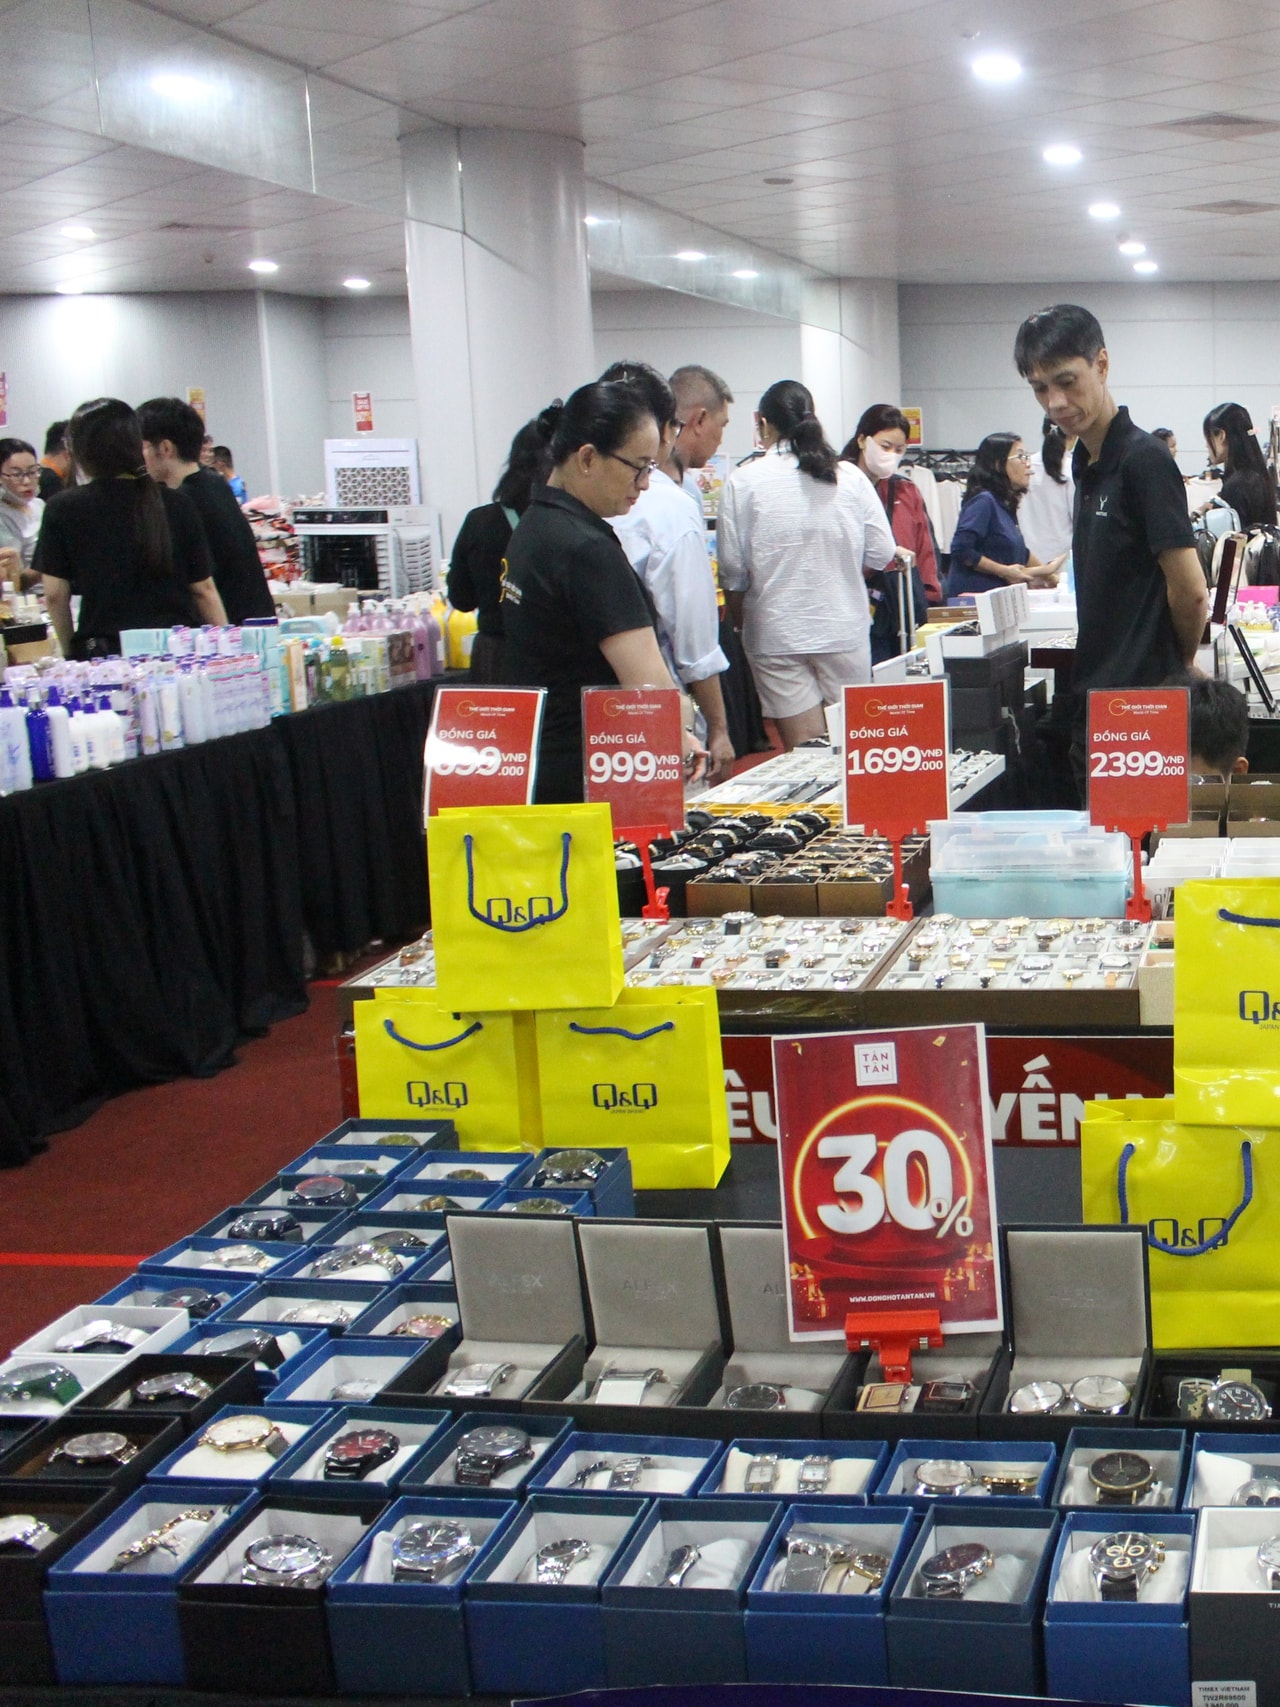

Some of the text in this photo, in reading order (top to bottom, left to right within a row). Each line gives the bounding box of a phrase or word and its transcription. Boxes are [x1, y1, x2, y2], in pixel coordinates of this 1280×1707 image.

[476, 728, 497, 740] GIÁ
[887, 724, 909, 737] GIÁ
[1130, 729, 1151, 741] GIÁ
[625, 731, 647, 744] GIÁ
[501, 752, 527, 763] VNĐ
[847, 745, 943, 776] 1699 VNĐ
[1090, 750, 1185, 778] 2399 VNĐ
[589, 750, 680, 784] 999 VNĐ
[862, 1050, 888, 1062] TÂN
[864, 1062, 889, 1073] TÂN
[406, 1081, 468, 1108] Q&Q
[592, 1083, 657, 1110] Q&Q
[723, 1069, 777, 1139] ÊU
[849, 1292, 936, 1303] WWW.DONGHOTANTAN.VN
